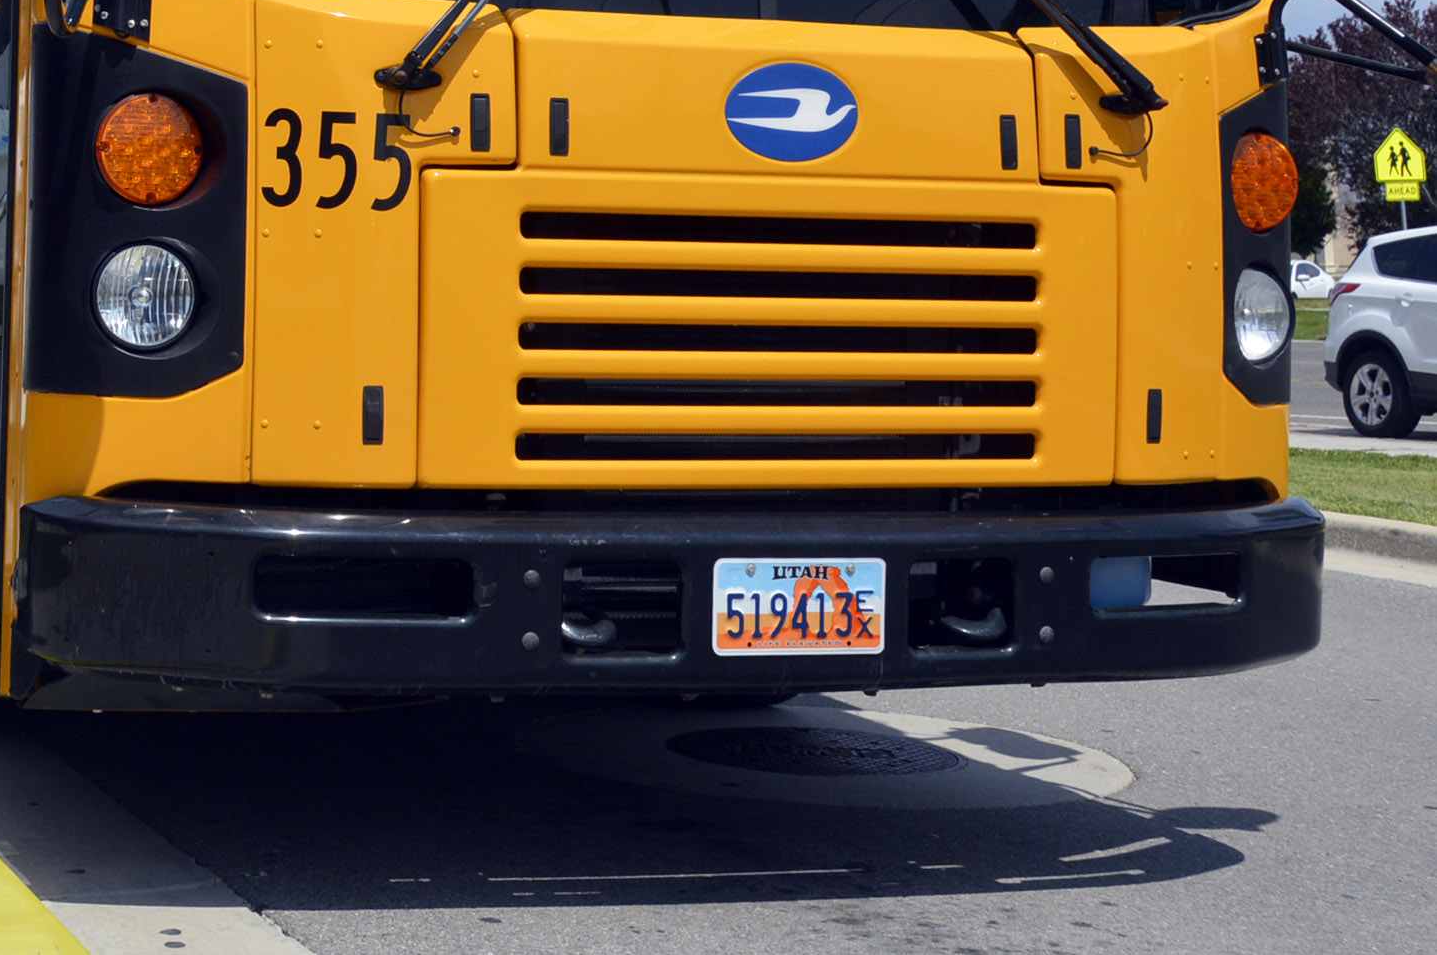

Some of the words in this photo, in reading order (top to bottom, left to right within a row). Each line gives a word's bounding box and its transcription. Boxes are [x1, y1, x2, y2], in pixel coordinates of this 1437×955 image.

[261, 108, 412, 212] 355
[1388, 187, 1417, 195] AHEAD
[771, 565, 829, 580] UTAH
[726, 592, 853, 639] 519413
